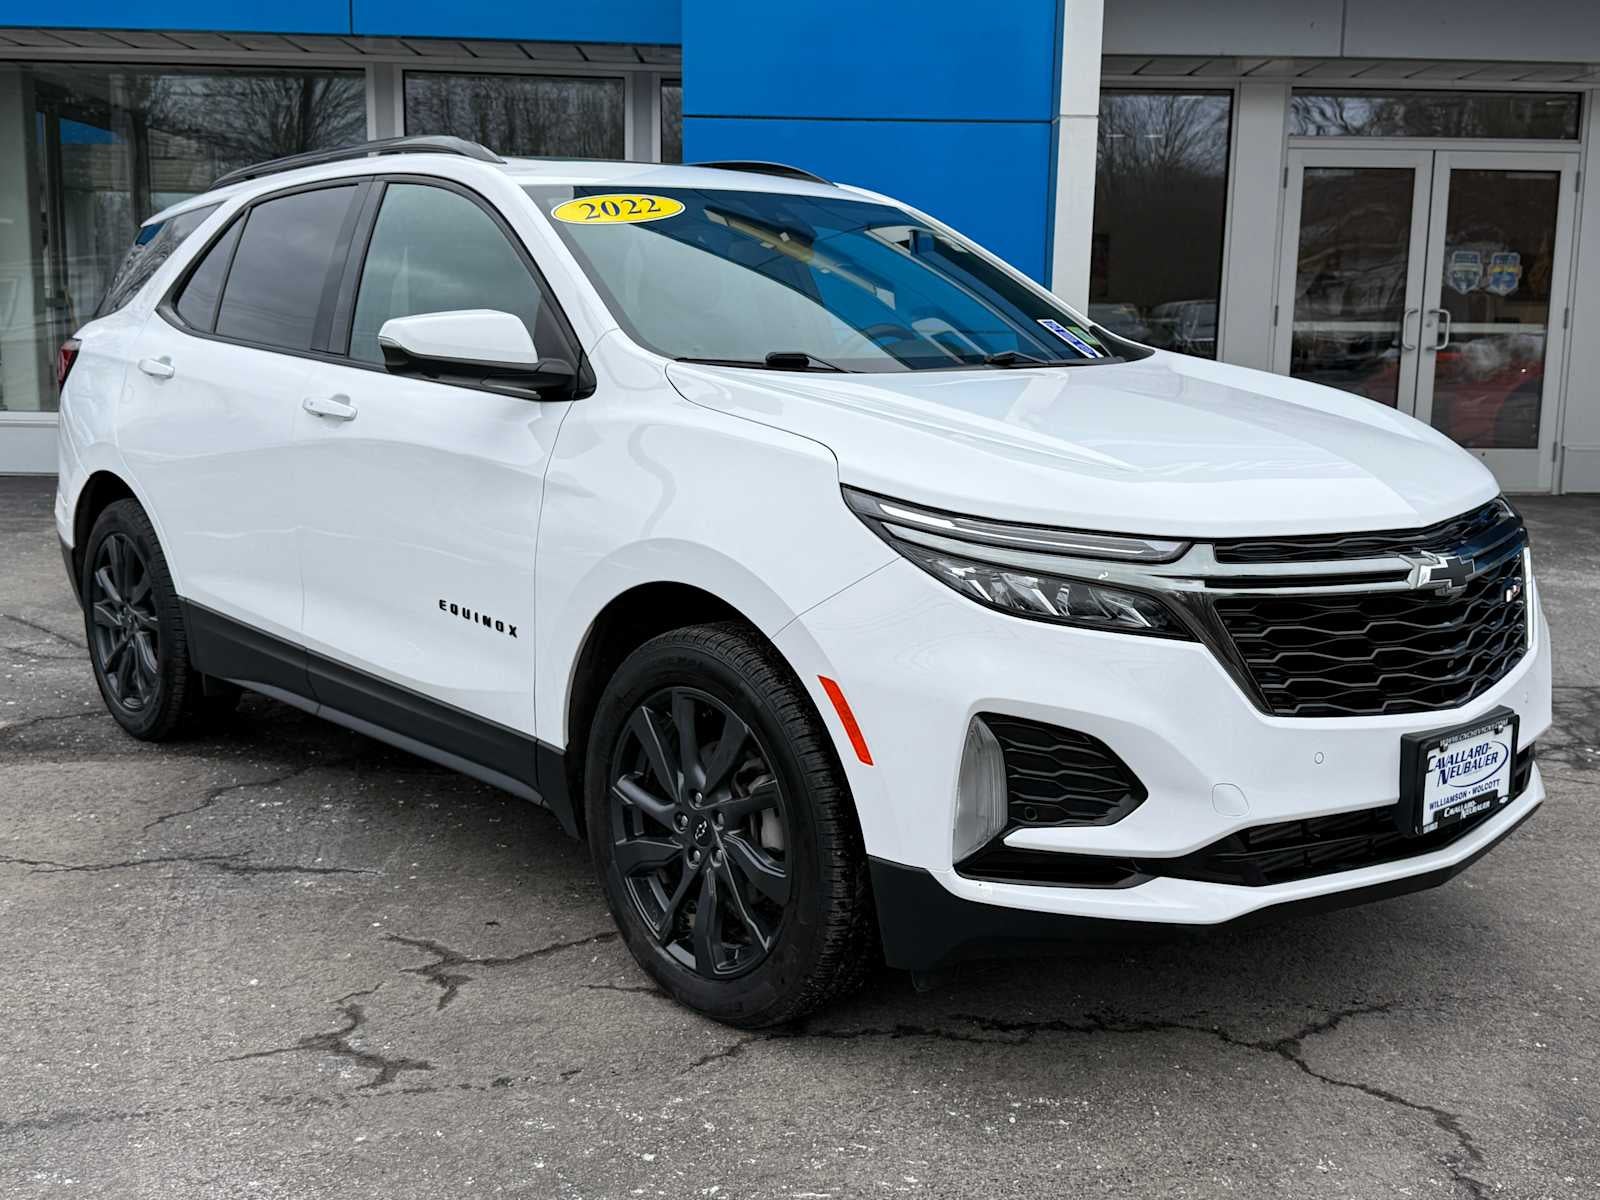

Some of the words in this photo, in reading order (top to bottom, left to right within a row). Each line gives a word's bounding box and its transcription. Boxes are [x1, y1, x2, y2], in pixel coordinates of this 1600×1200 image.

[578, 197, 662, 221] 2022
[438, 598, 518, 639] EQUINOX
[1437, 751, 1499, 787] NEUBAUER
[1429, 788, 1467, 811] WILLIAMSON
[1472, 779, 1501, 795] WOLCOTT
